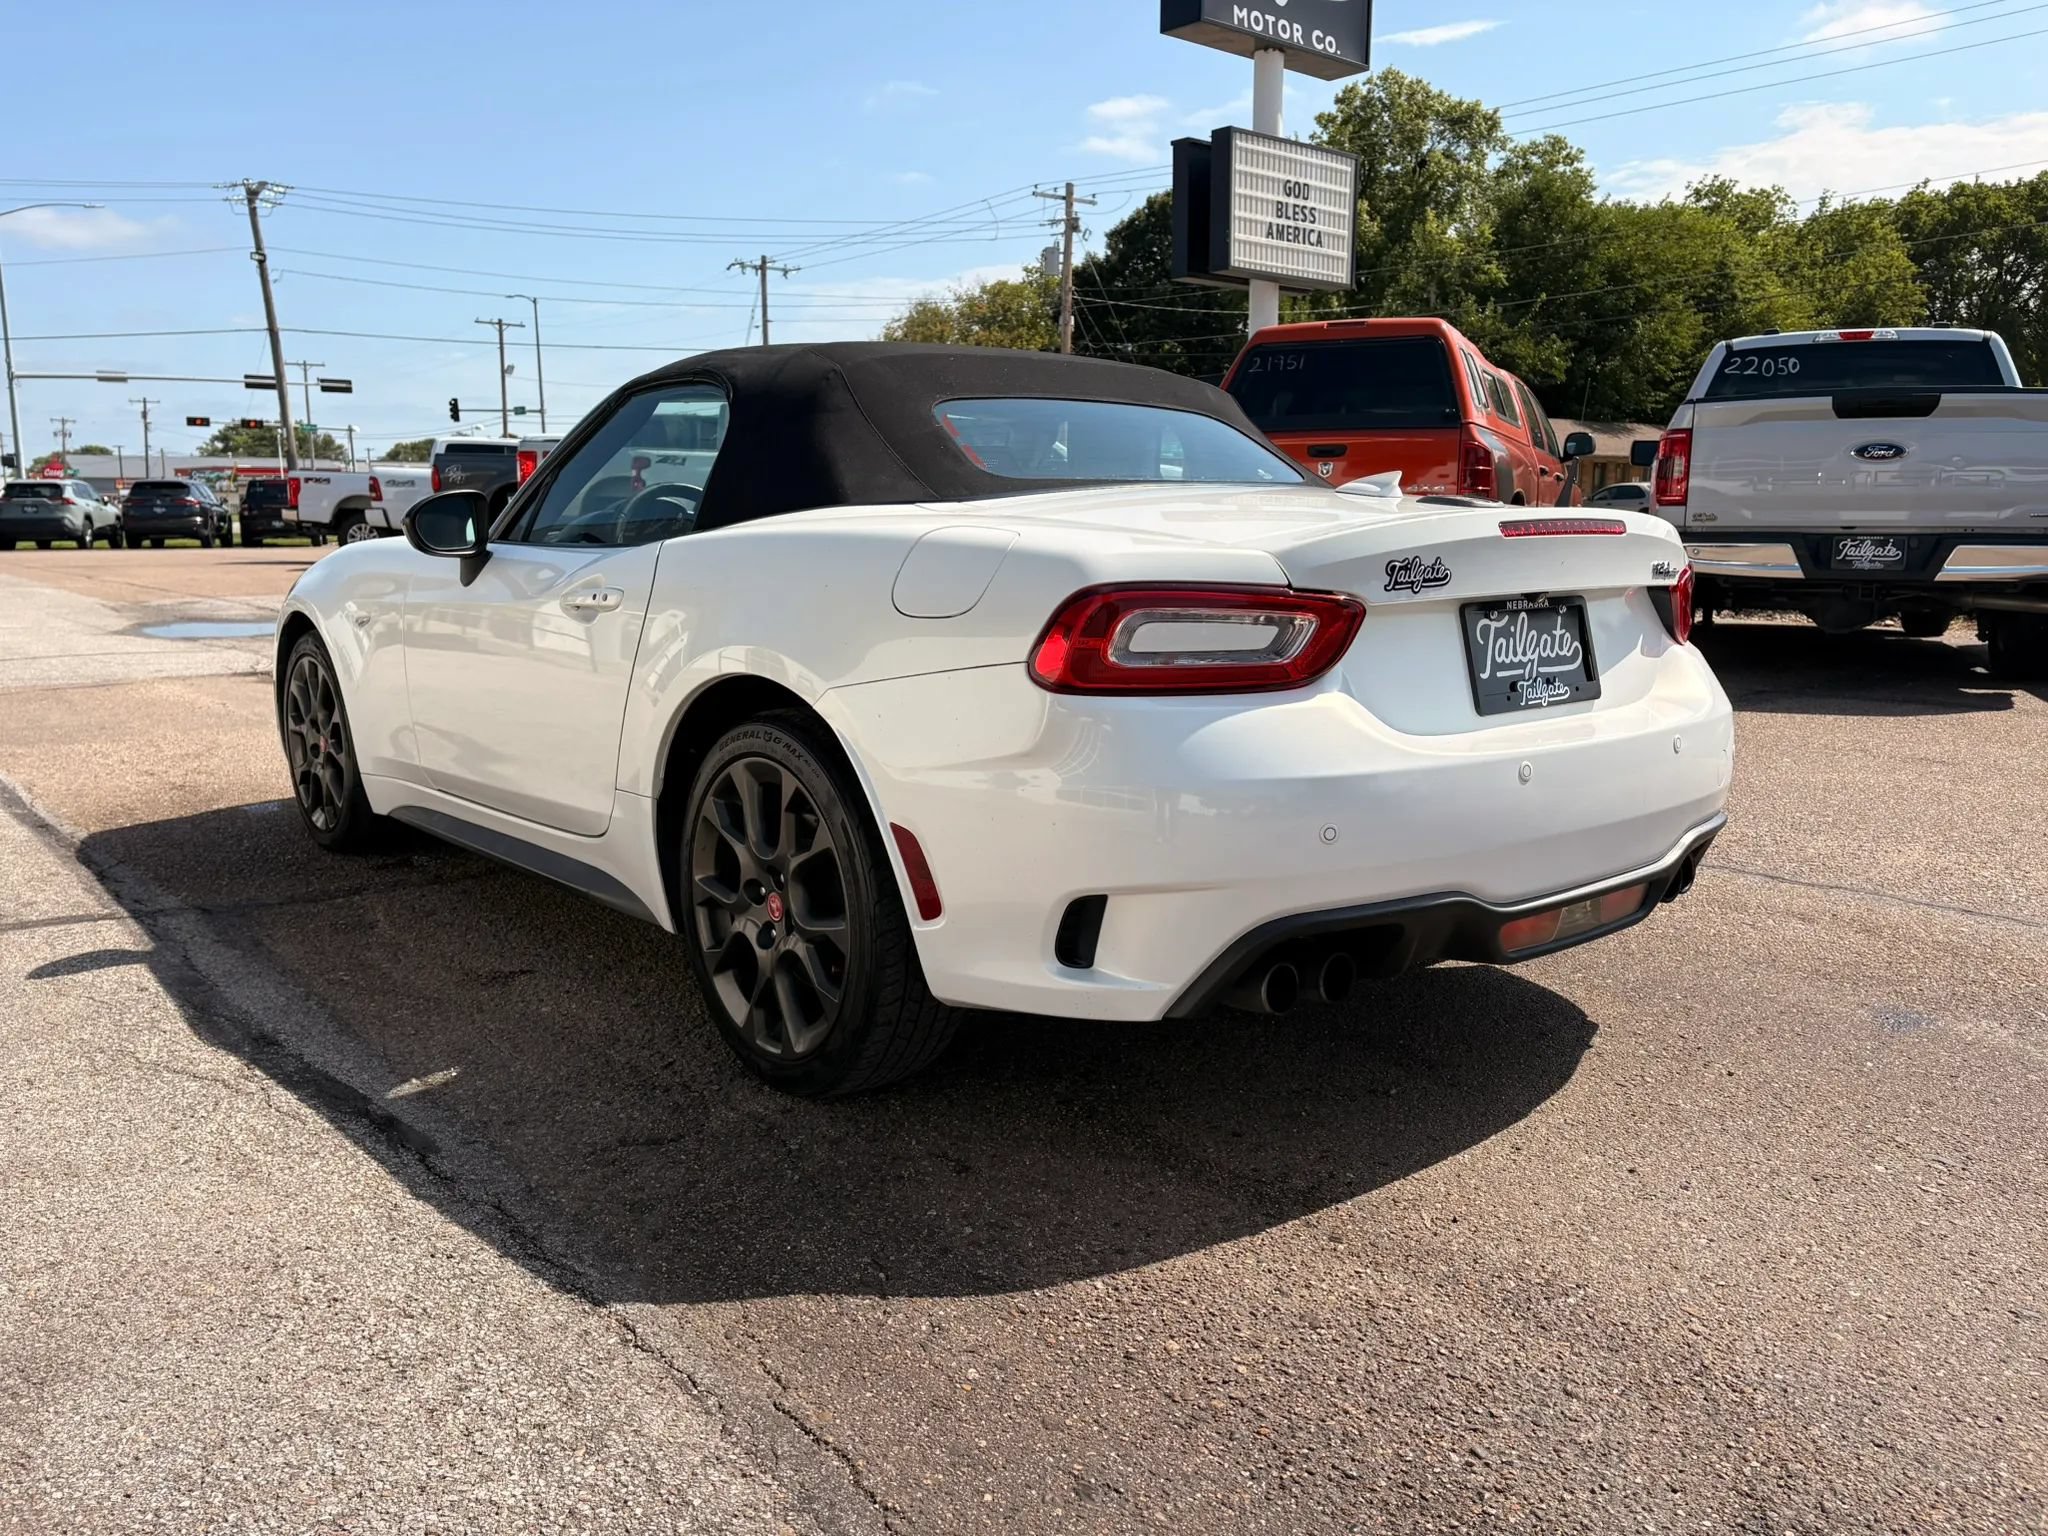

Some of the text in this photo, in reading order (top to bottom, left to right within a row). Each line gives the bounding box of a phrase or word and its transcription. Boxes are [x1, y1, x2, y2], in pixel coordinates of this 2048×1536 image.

[1233, 4, 1341, 54] MOTOR CO.
[1283, 179, 1310, 200] GOD
[1276, 201, 1317, 224] BLESS
[1266, 222, 1323, 248] AMERICA
[1724, 356, 1800, 377] 22050
[1863, 445, 1896, 458] Ford
[1836, 538, 1902, 562] Tailgate
[1384, 556, 1452, 594] Tailgate
[1476, 611, 1583, 681] Tailgate
[1517, 676, 1571, 706] Tailgate
[719, 729, 762, 752] GENERAL
